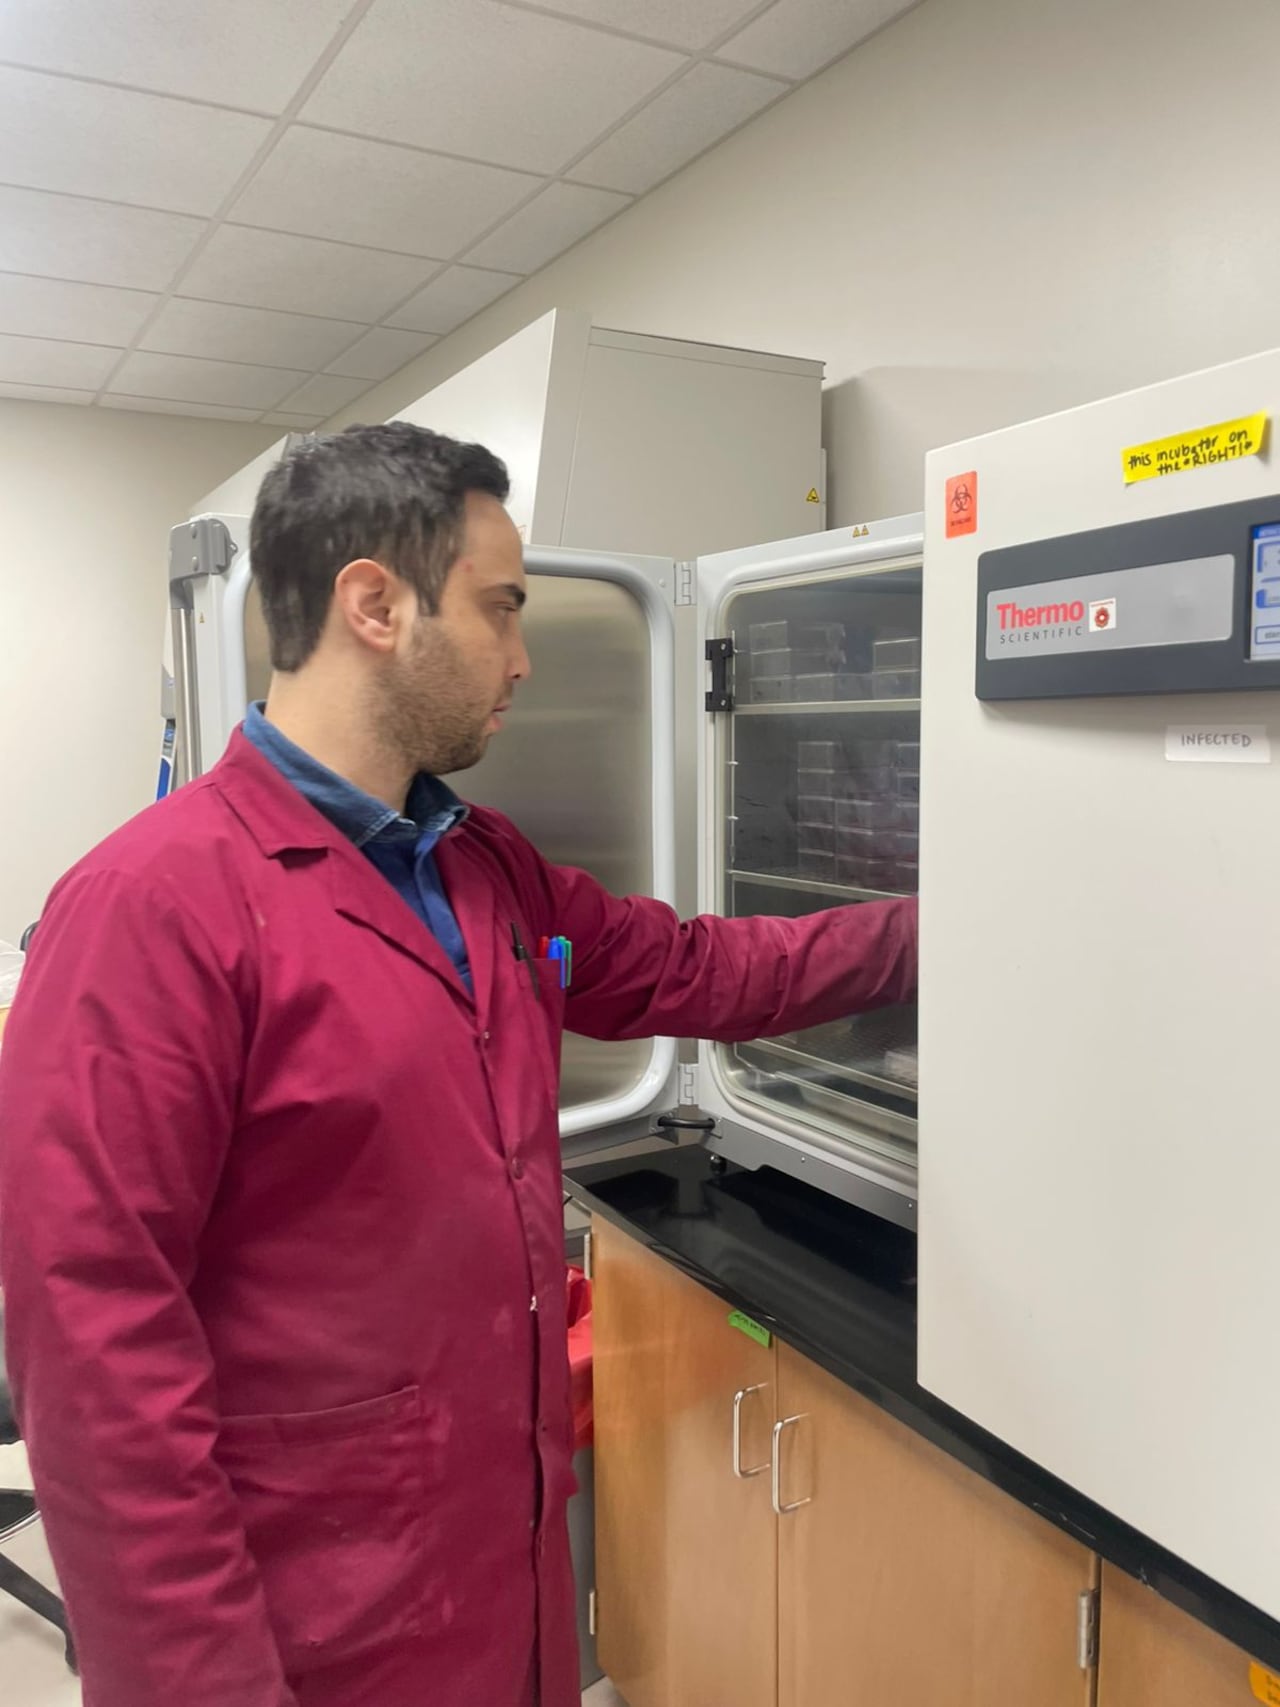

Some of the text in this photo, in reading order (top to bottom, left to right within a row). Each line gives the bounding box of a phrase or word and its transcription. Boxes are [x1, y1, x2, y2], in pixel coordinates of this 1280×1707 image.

[1128, 429, 1248, 469] this incubator on
[1157, 461, 1181, 476] the
[996, 600, 1085, 630] Thermo
[999, 625, 1083, 644] SCIENTIFIC
[1181, 733, 1252, 748] INFECTED
